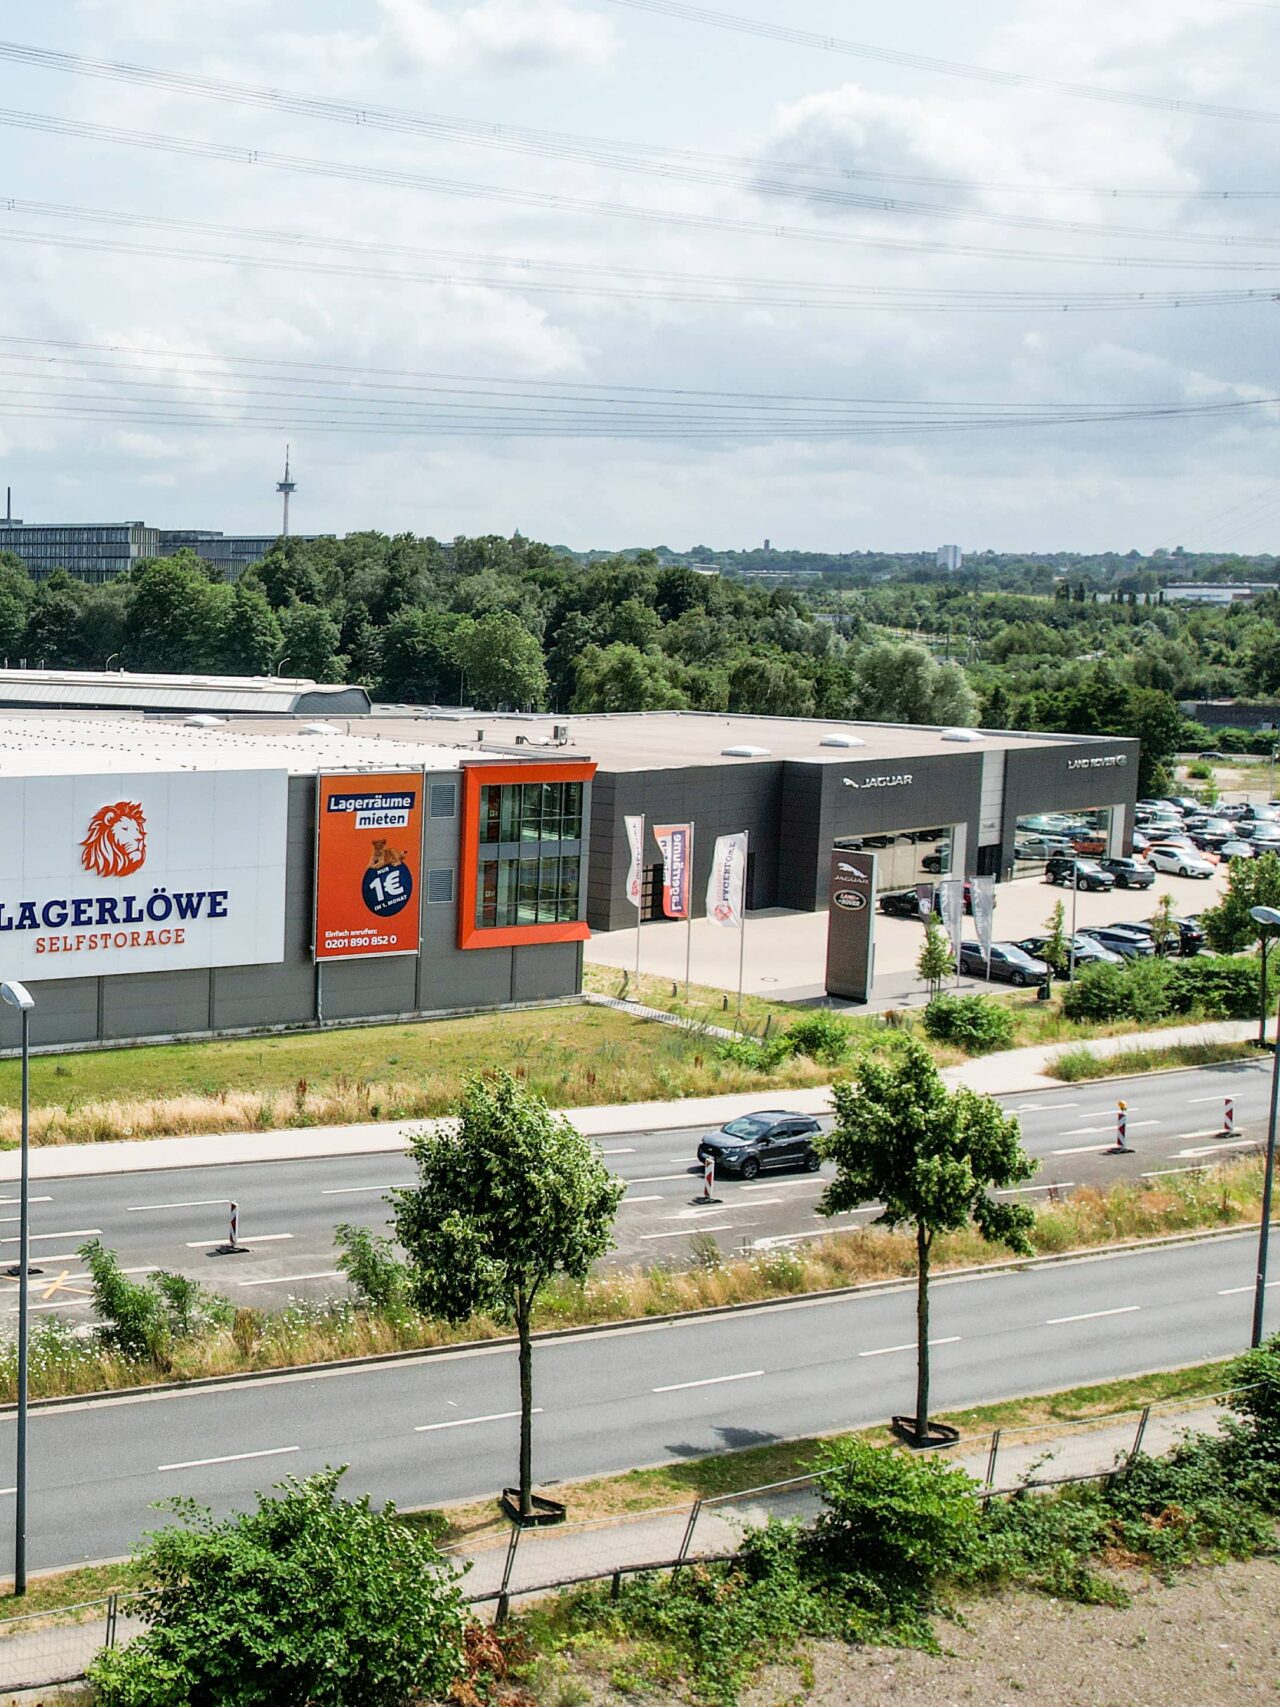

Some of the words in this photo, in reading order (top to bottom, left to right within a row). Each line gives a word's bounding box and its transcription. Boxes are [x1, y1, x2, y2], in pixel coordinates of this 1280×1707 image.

[861, 774, 913, 788] JAGUAR
[330, 795, 411, 813] Lagerräume
[359, 812, 405, 827] mieten
[377, 866, 390, 875] NUR
[369, 870, 404, 902] 1€
[833, 875, 869, 884] JAGUAR
[387, 894, 408, 906] MONAT
[325, 929, 349, 938] Einfach
[350, 927, 378, 936] anrufen:
[36, 928, 186, 954] SELFSTORAGE
[325, 938, 349, 949] 0201
[350, 937, 369, 947] 890
[371, 935, 389, 945] 852
[390, 934, 397, 944] 0
